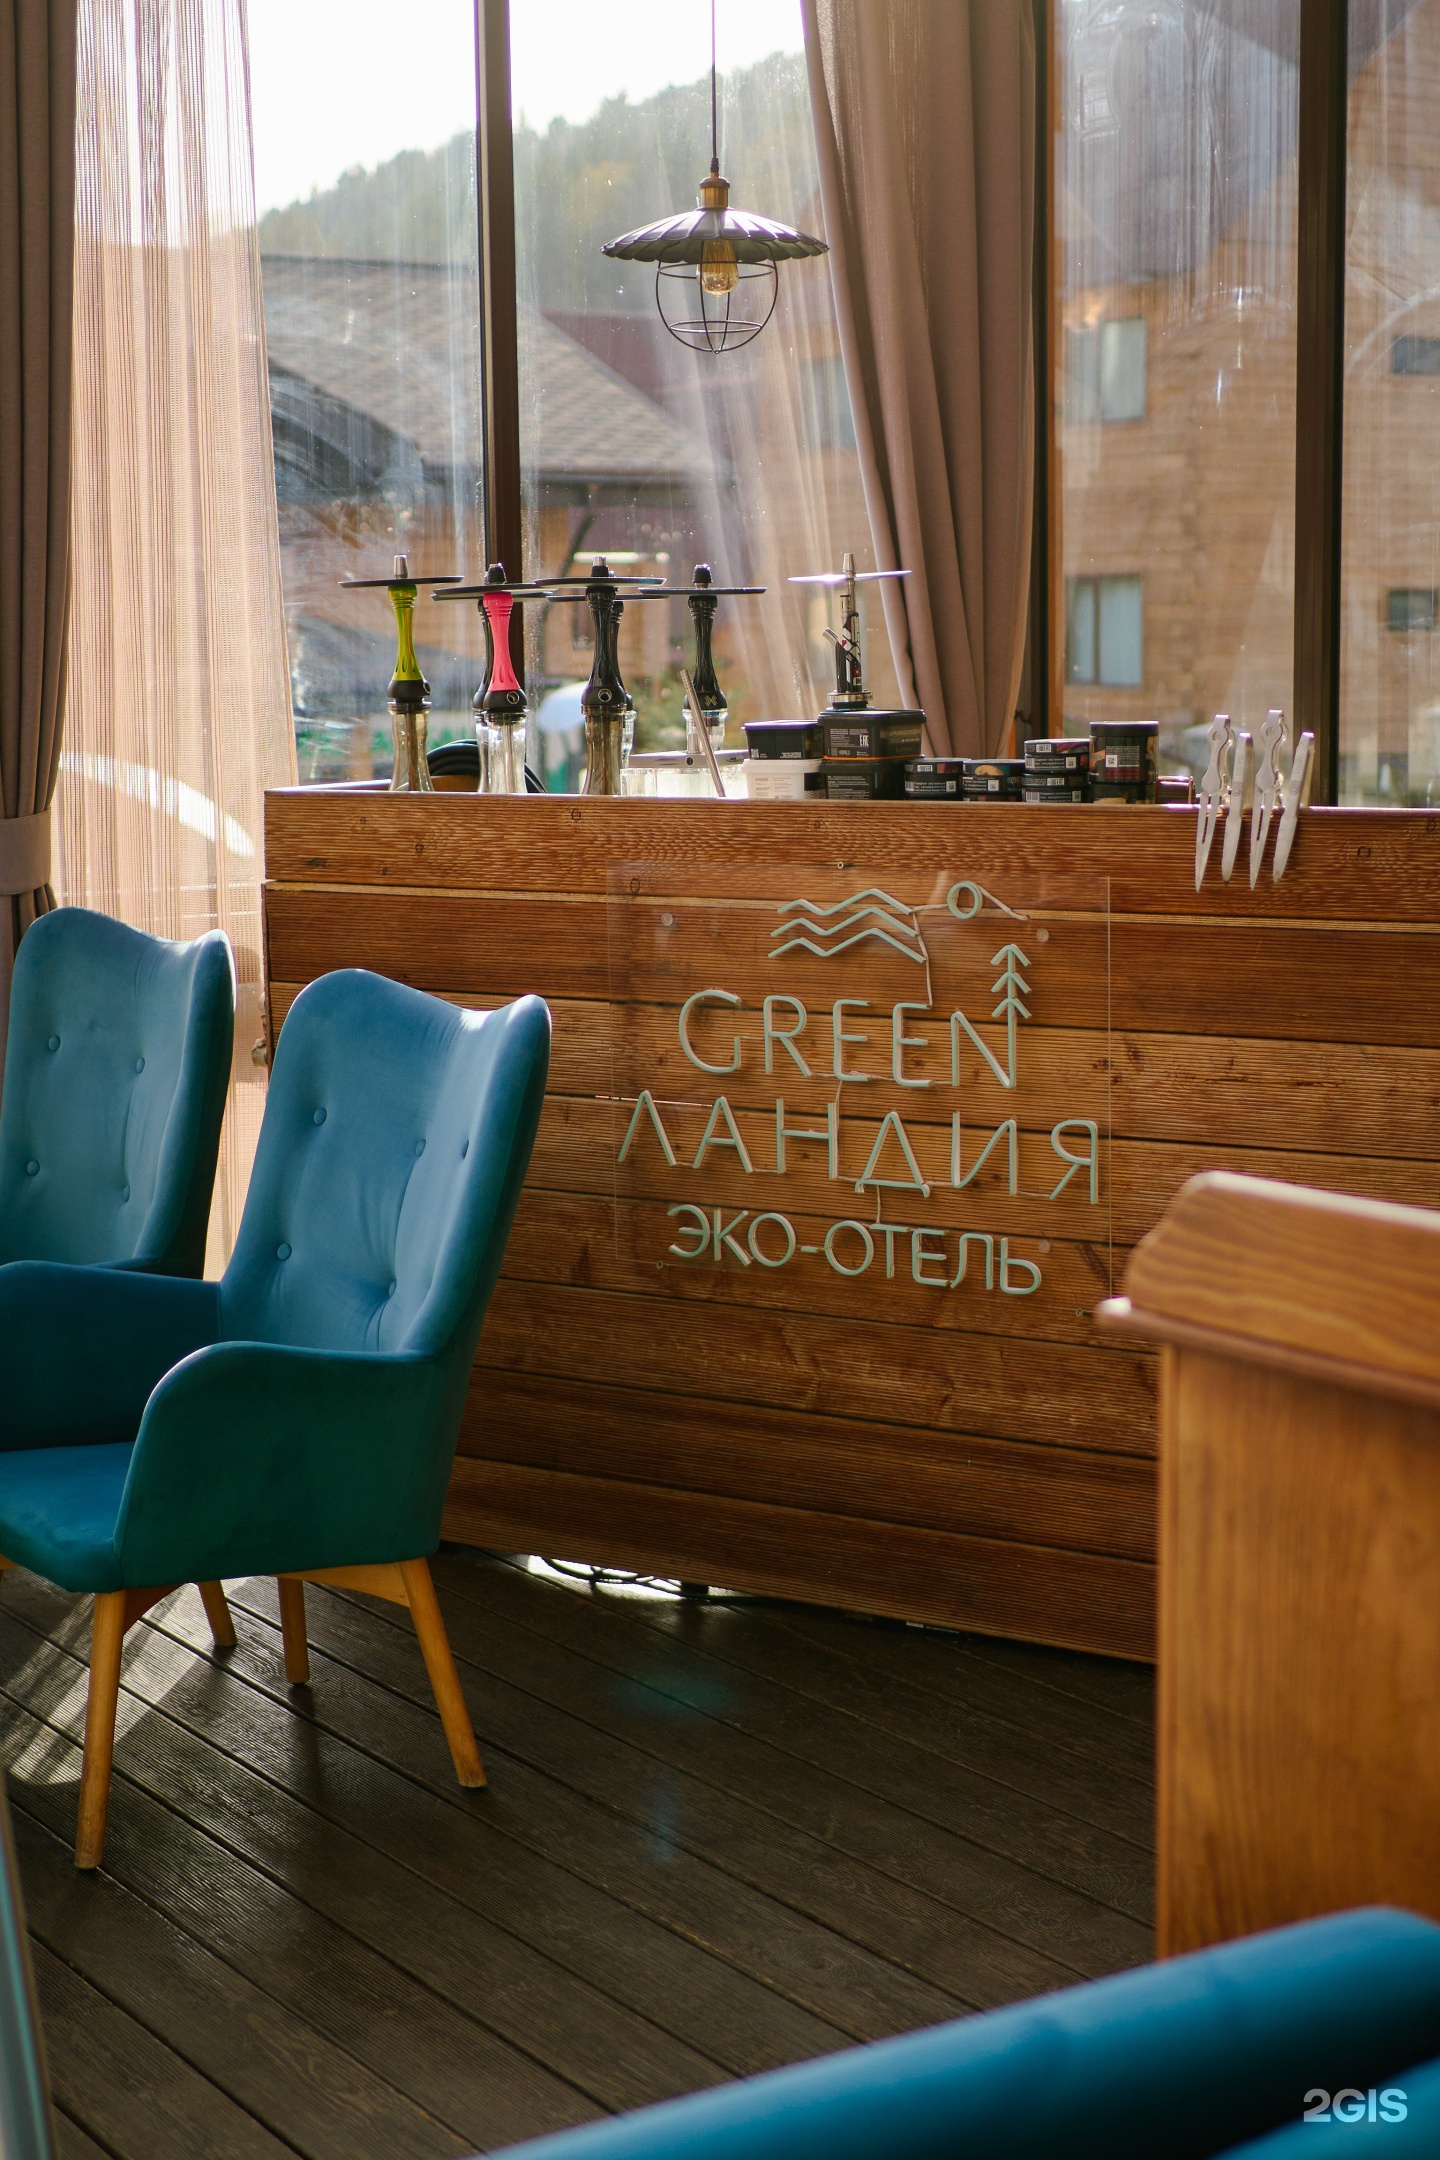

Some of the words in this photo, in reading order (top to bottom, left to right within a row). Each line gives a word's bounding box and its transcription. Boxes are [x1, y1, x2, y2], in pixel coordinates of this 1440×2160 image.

[679, 989, 1017, 1089] GREEN
[618, 1090, 1098, 1204] ЛАНДИЯ
[667, 1204, 1042, 1295] ЭКО-ОТЕЛЬ
